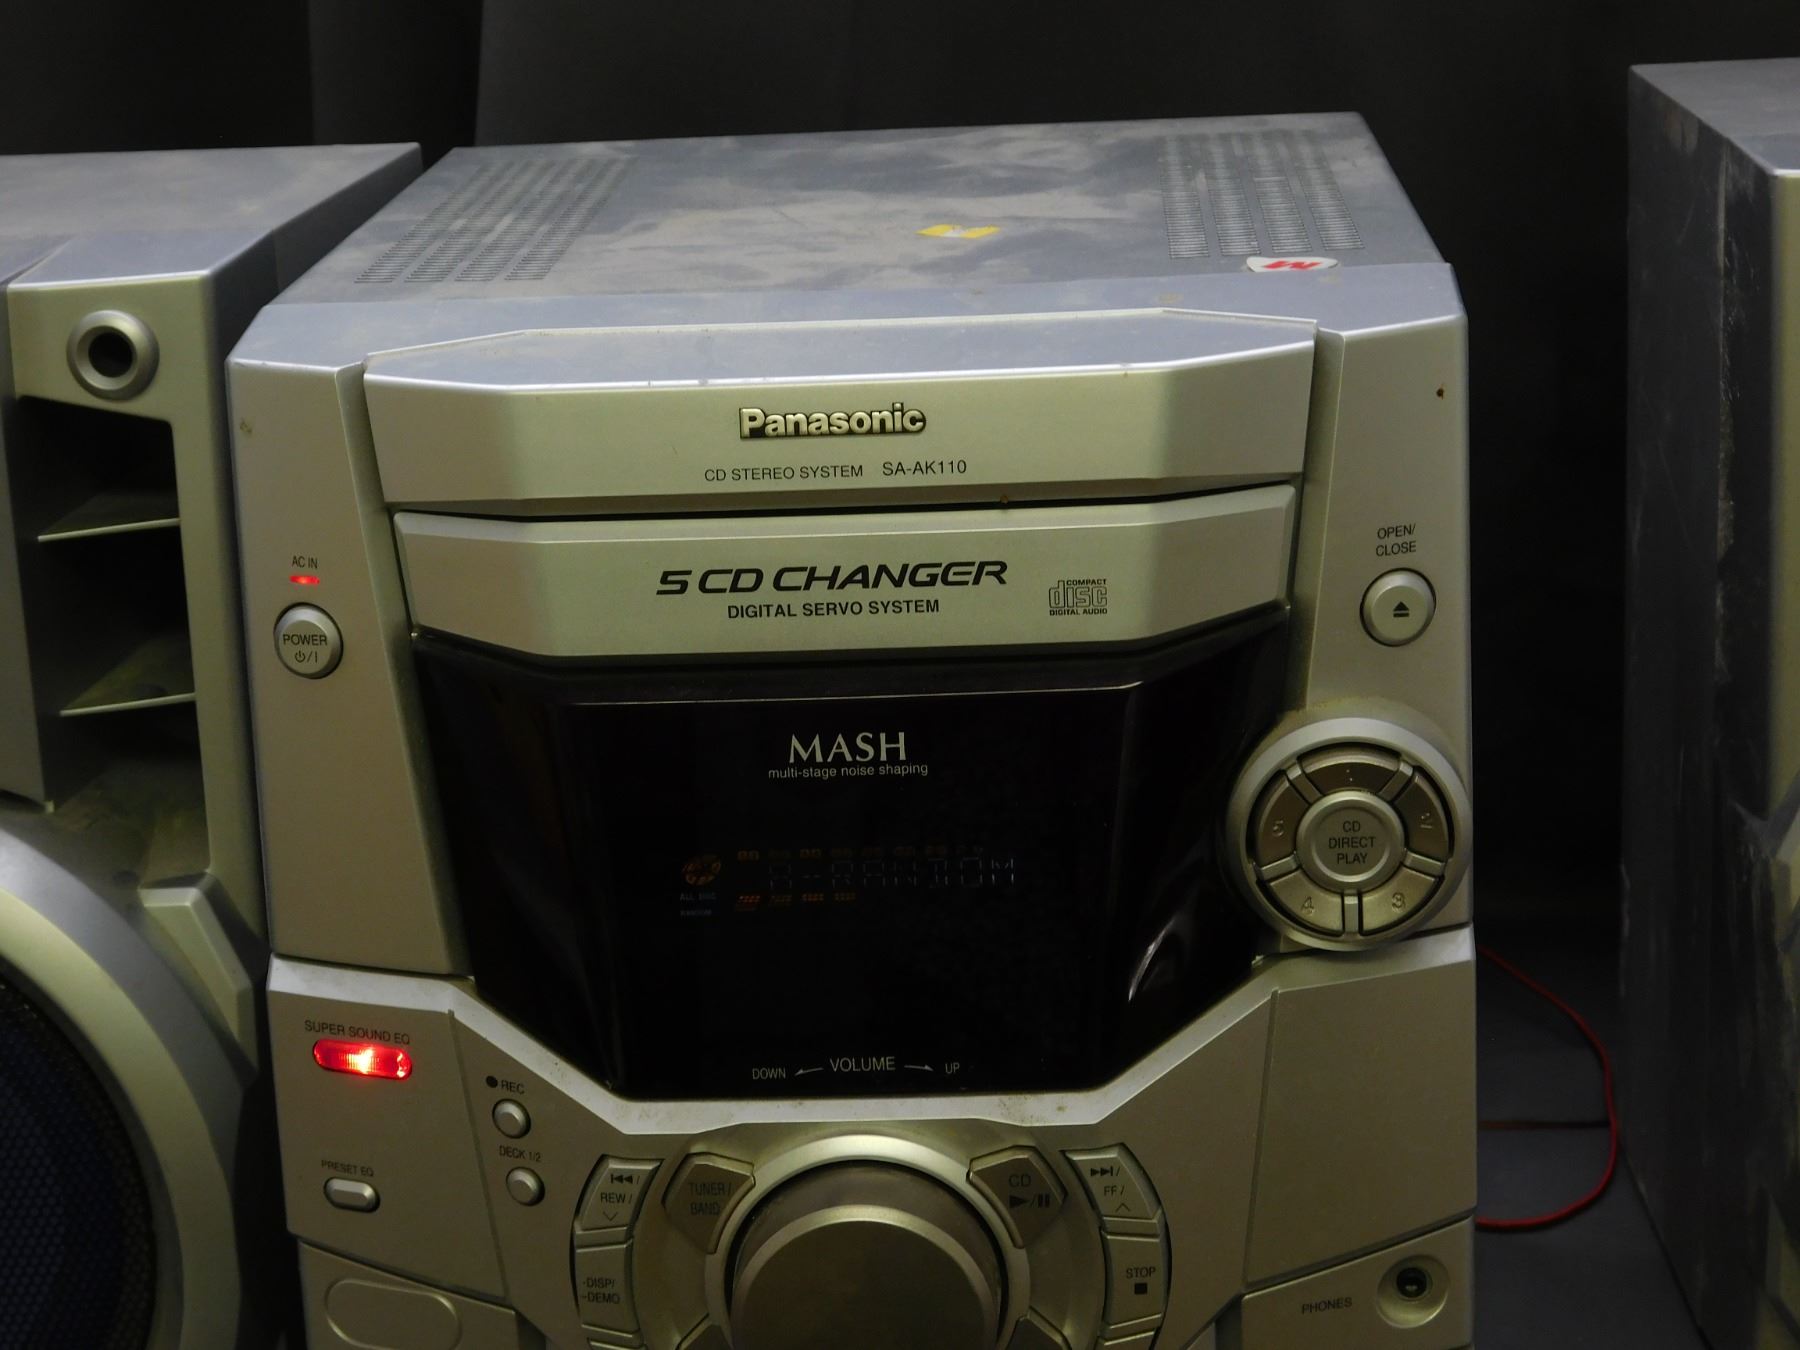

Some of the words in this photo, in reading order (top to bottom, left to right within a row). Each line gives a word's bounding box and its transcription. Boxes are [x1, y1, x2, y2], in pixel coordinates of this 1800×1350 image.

[739, 402, 926, 439] Panasonic
[704, 469, 726, 482] CD
[731, 466, 795, 481] STEREO
[799, 464, 864, 479] SYSTEM
[882, 460, 967, 477] SA-AK110
[1377, 524, 1416, 540] OPEN/
[1375, 541, 1417, 557] CLOSE
[292, 556, 305, 568] AC
[308, 557, 318, 569] IN
[656, 569, 693, 595] 5
[698, 568, 764, 594] CD
[772, 560, 1008, 592] CHANGER
[727, 604, 797, 619] DIGITAL
[802, 602, 863, 617] SERVO
[868, 599, 940, 615] SYSTEM
[283, 633, 327, 646] POWER
[789, 732, 907, 763] MASH
[768, 763, 837, 780] multi-stage
[841, 764, 875, 777] noise
[878, 763, 928, 778] shaping
[1342, 821, 1361, 833] CD
[1328, 836, 1376, 850] DIRECT
[1336, 853, 1368, 866] PLAY
[304, 1020, 346, 1037] SUPER
[348, 1026, 391, 1042] SOUND
[394, 1032, 411, 1045] EQ
[752, 1067, 786, 1080] DOWN
[830, 1056, 896, 1073] VOLUME
[945, 1062, 961, 1075] UP
[501, 1080, 526, 1095] REC
[499, 1146, 527, 1159] DECK
[321, 1160, 359, 1175] PRESET
[361, 1167, 375, 1177] EQ
[1008, 1174, 1033, 1188] CD
[690, 1203, 721, 1216] BAND
[1125, 1266, 1156, 1280] STOP
[1301, 1297, 1353, 1314] PHONES
